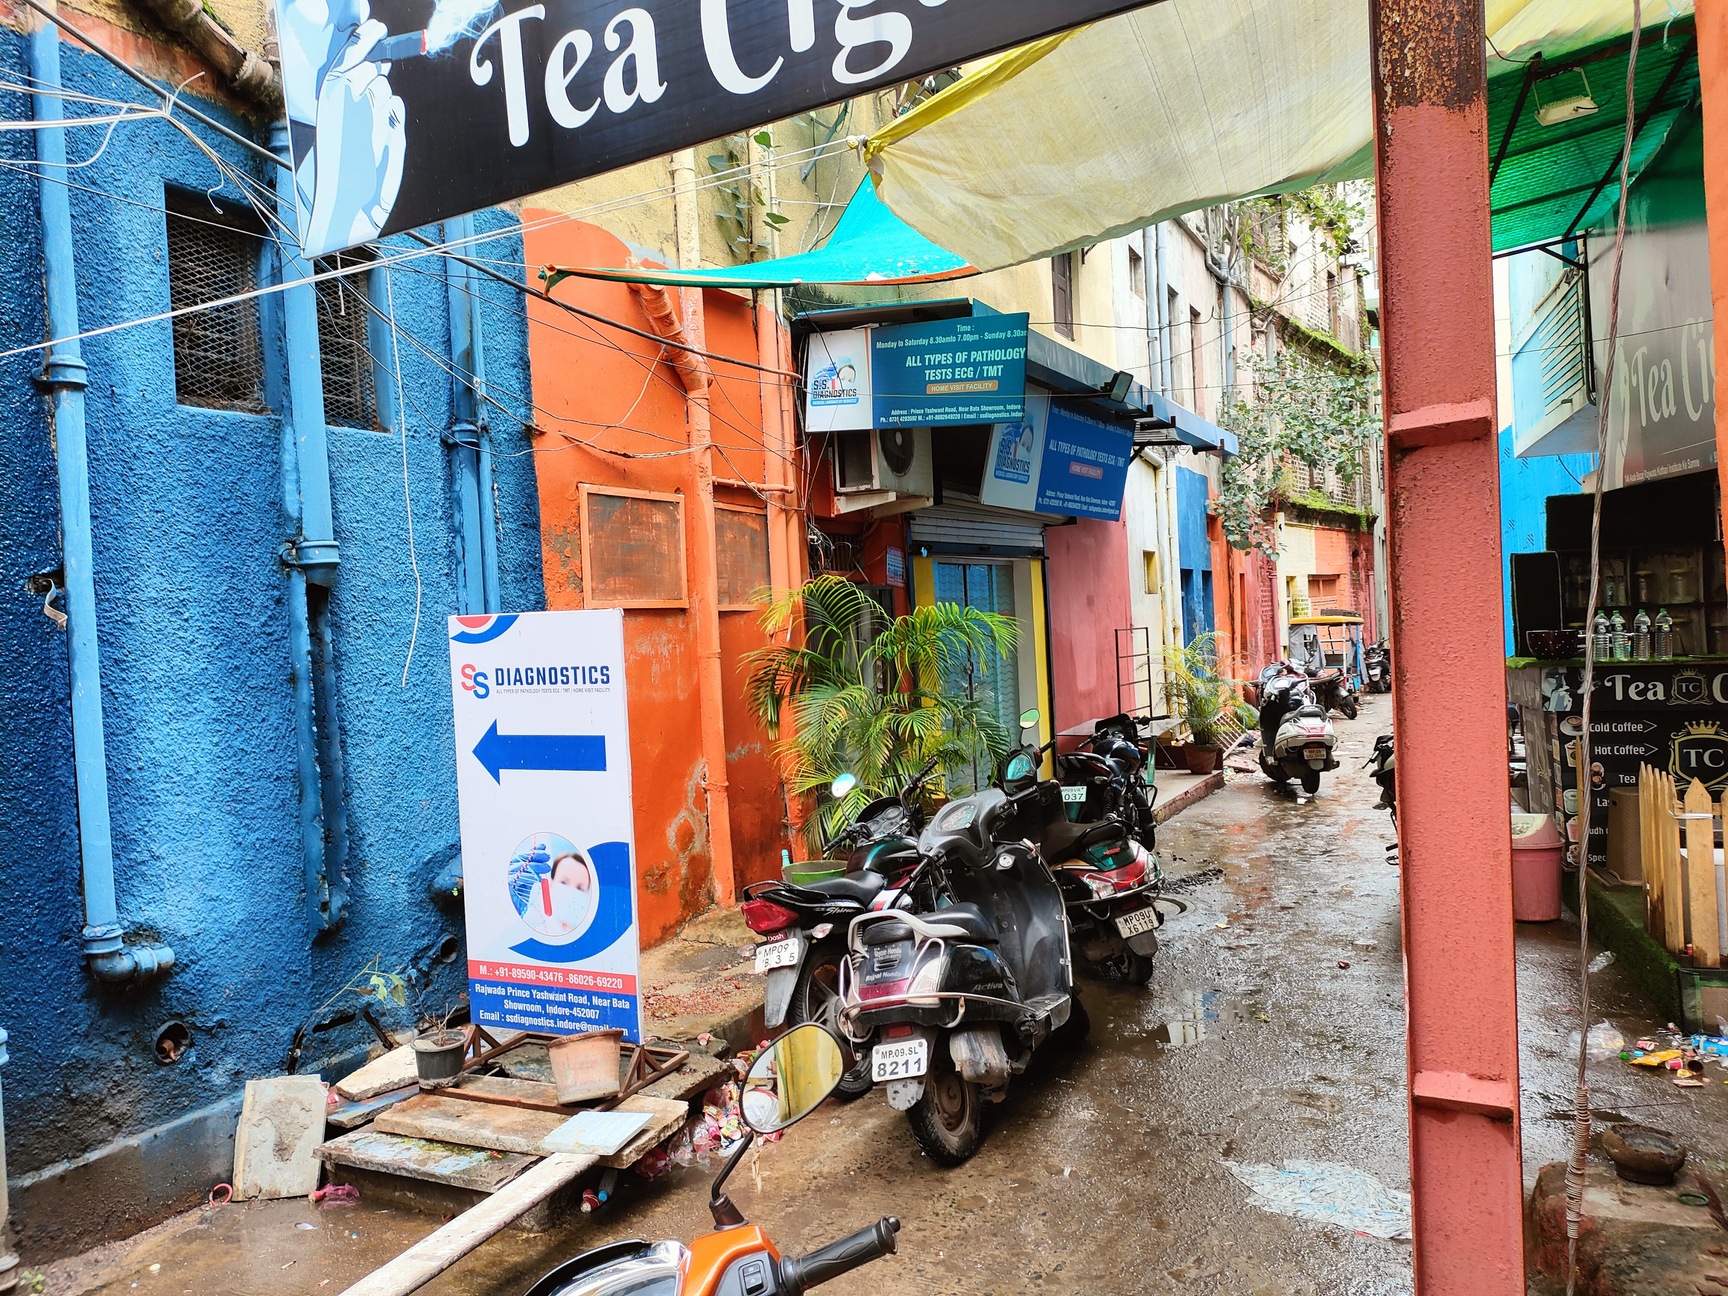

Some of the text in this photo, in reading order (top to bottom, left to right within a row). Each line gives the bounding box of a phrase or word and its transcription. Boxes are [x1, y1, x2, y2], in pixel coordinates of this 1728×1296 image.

[470, 3, 668, 147] Tea
[957, 324, 971, 333] Time
[876, 340, 897, 350] Monday
[904, 337, 929, 347] Saturday
[957, 333, 979, 342] 7.00pm
[984, 331, 1006, 340] Sunday
[906, 347, 1026, 367] ALL TYPES OF PATHOLOGY
[924, 369, 953, 381] TESTS
[955, 366, 974, 379] ECG
[983, 365, 1004, 377] TMT
[1631, 316, 1716, 427] Tea Ci
[812, 388, 857, 399] DIAGNOSTICS
[931, 382, 993, 392] HOME VISIT FACILITY
[495, 666, 610, 686] DIAGNOSTICS
[1604, 674, 1666, 701] Tea
[1680, 682, 1700, 693] TC
[1589, 721, 1643, 733] Cold Coffee
[1594, 744, 1645, 755] Hot Coffee
[1683, 748, 1725, 768] TC
[1619, 774, 1636, 784] Tea
[1588, 826, 1604, 835] udh
[1127, 919, 1155, 935] X6119
[763, 943, 789, 957] MP09
[479, 965, 623, 989] M.: +91-89590-43476 -86026-69220
[971, 982, 1003, 992] Activa
[475, 983, 630, 1009] Rajwada Prince Yashwant Road, Near Bata
[479, 1009, 500, 1021] Email
[503, 999, 600, 1020] Showroom, Indore-452007
[881, 1046, 918, 1060] MP.09.SL
[877, 1057, 922, 1077] 8211
